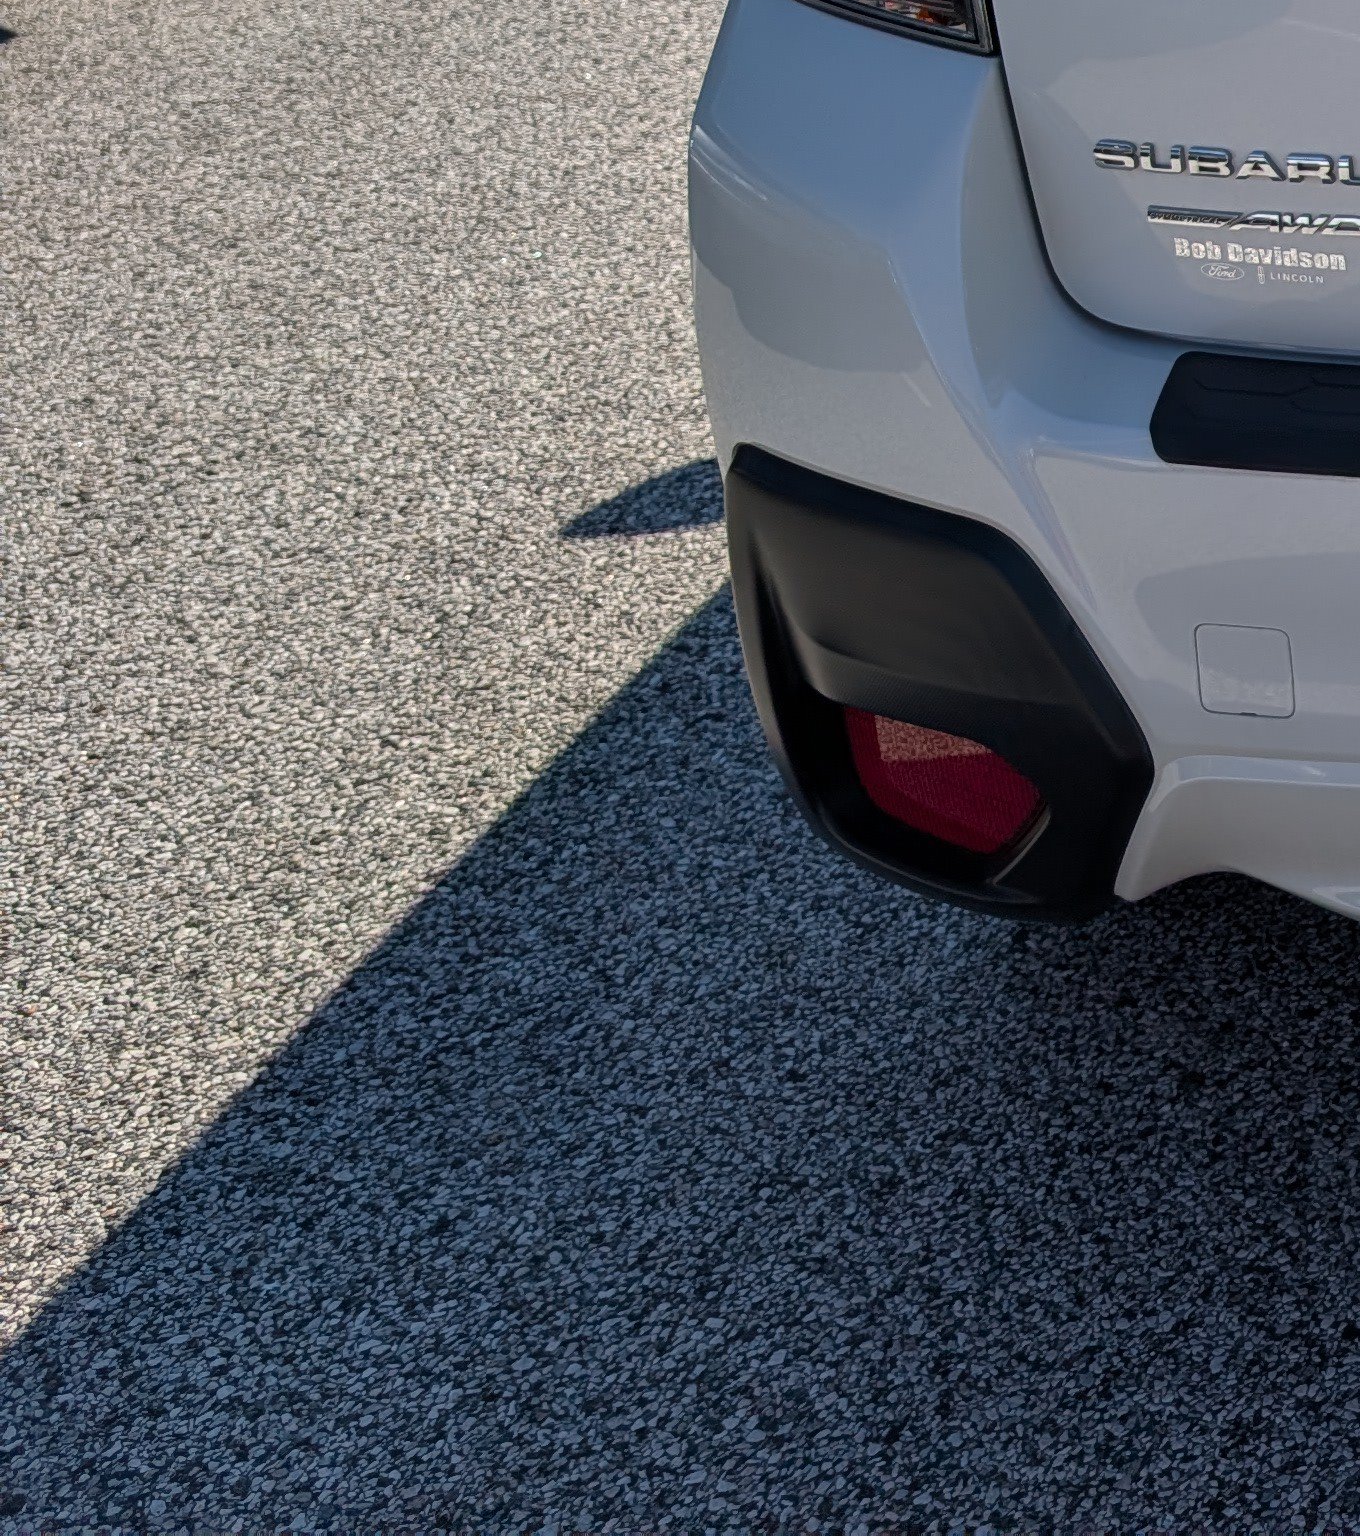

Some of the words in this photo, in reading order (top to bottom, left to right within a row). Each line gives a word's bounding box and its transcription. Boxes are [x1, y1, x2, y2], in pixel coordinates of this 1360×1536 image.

[1173, 237, 1222, 261] Bob
[1226, 243, 1347, 271] Davidson
[1208, 265, 1238, 279] Ford
[1270, 272, 1324, 284] LINCOLN
